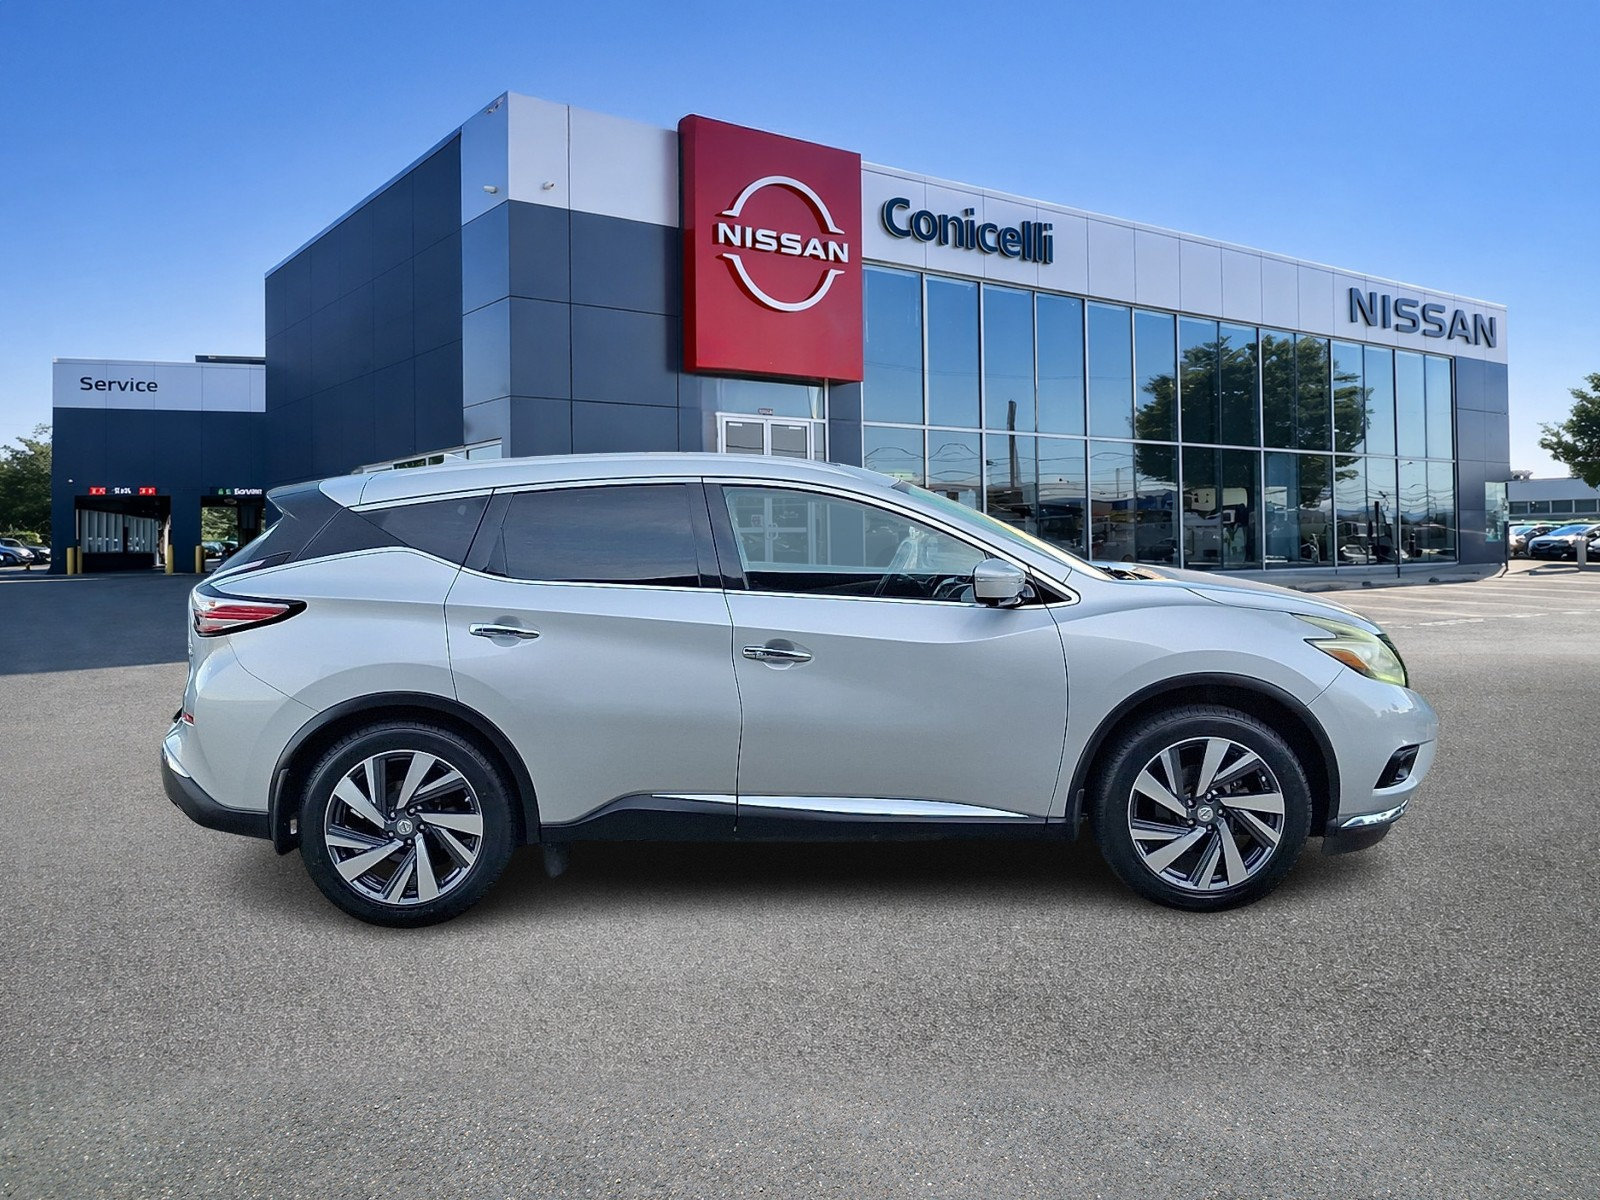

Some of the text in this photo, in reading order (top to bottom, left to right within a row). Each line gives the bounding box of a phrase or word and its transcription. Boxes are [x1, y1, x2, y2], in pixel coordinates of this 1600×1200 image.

[718, 222, 849, 263] NISSAN
[882, 197, 1053, 264] Conicelli
[1348, 287, 1497, 348] NISSAN
[80, 376, 158, 393] Service
